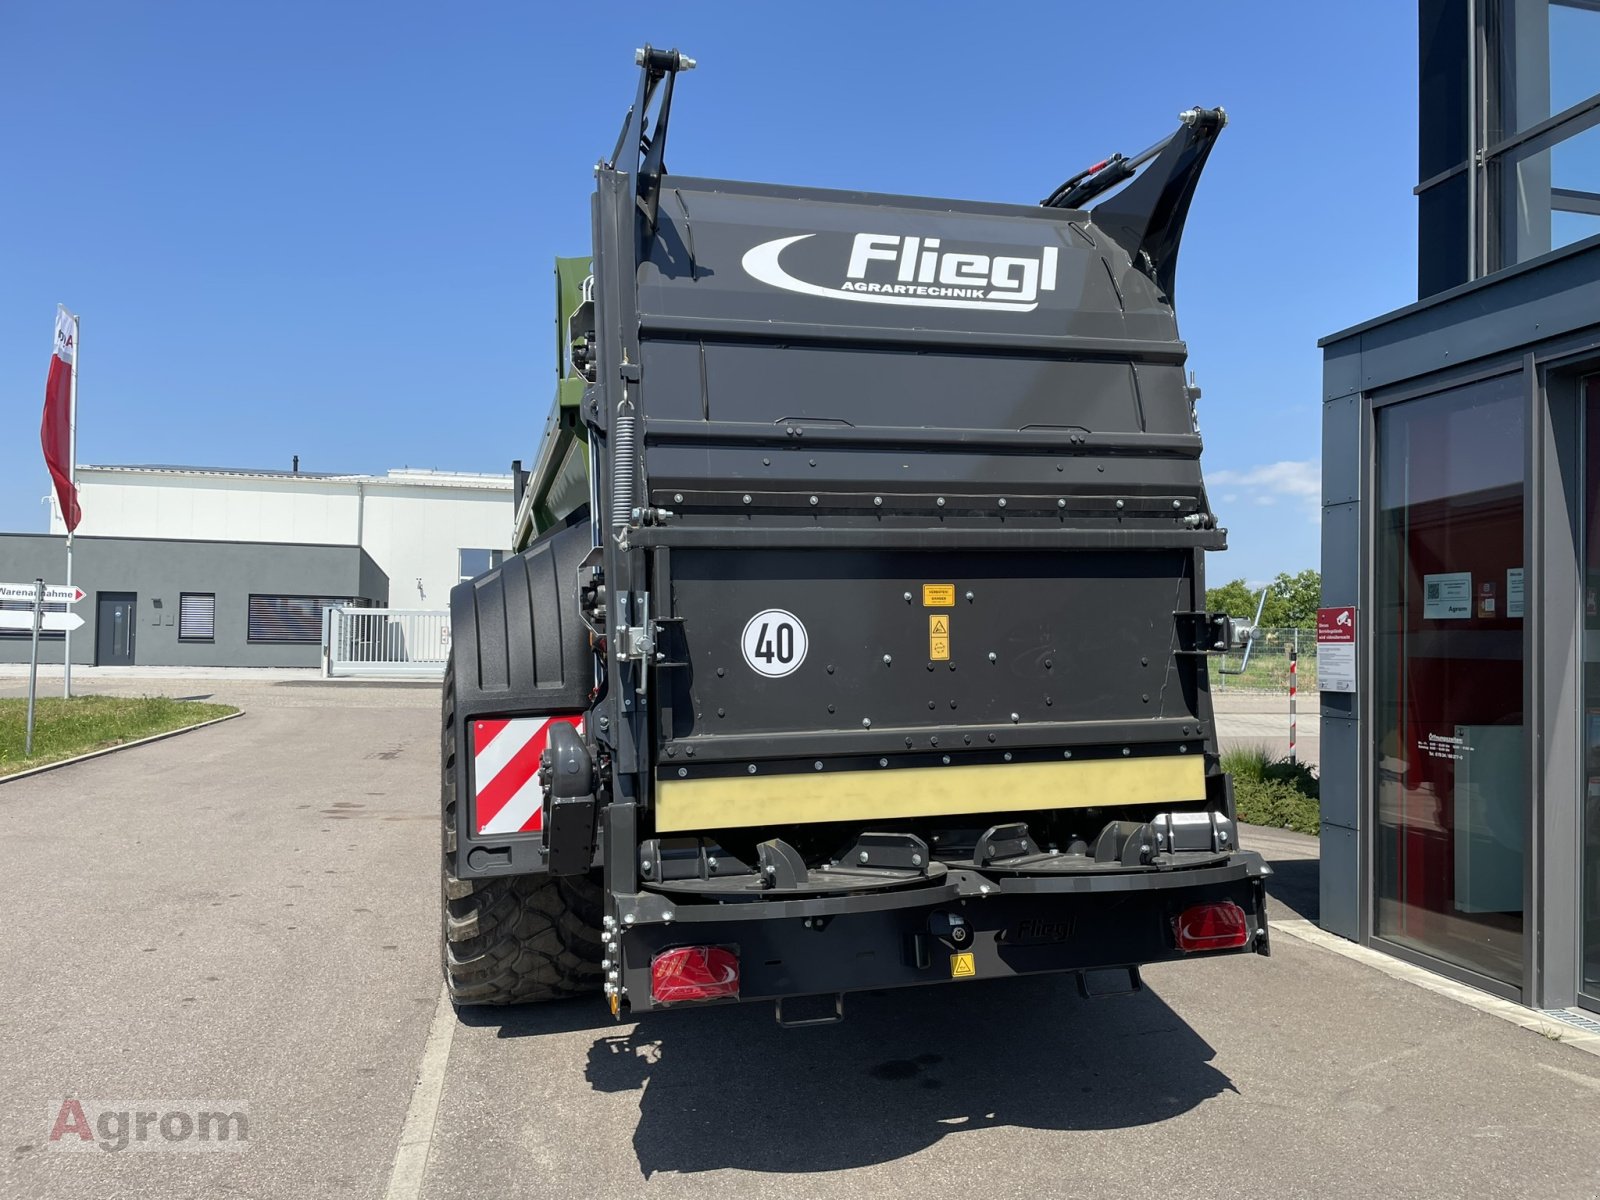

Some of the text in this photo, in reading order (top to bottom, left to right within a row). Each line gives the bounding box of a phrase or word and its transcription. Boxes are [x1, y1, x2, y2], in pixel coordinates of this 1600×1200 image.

[846, 232, 1058, 301] Fliegl
[841, 281, 985, 299] AGRARTECHNIK
[755, 622, 794, 664] 40
[1018, 915, 1078, 941] Fliegl
